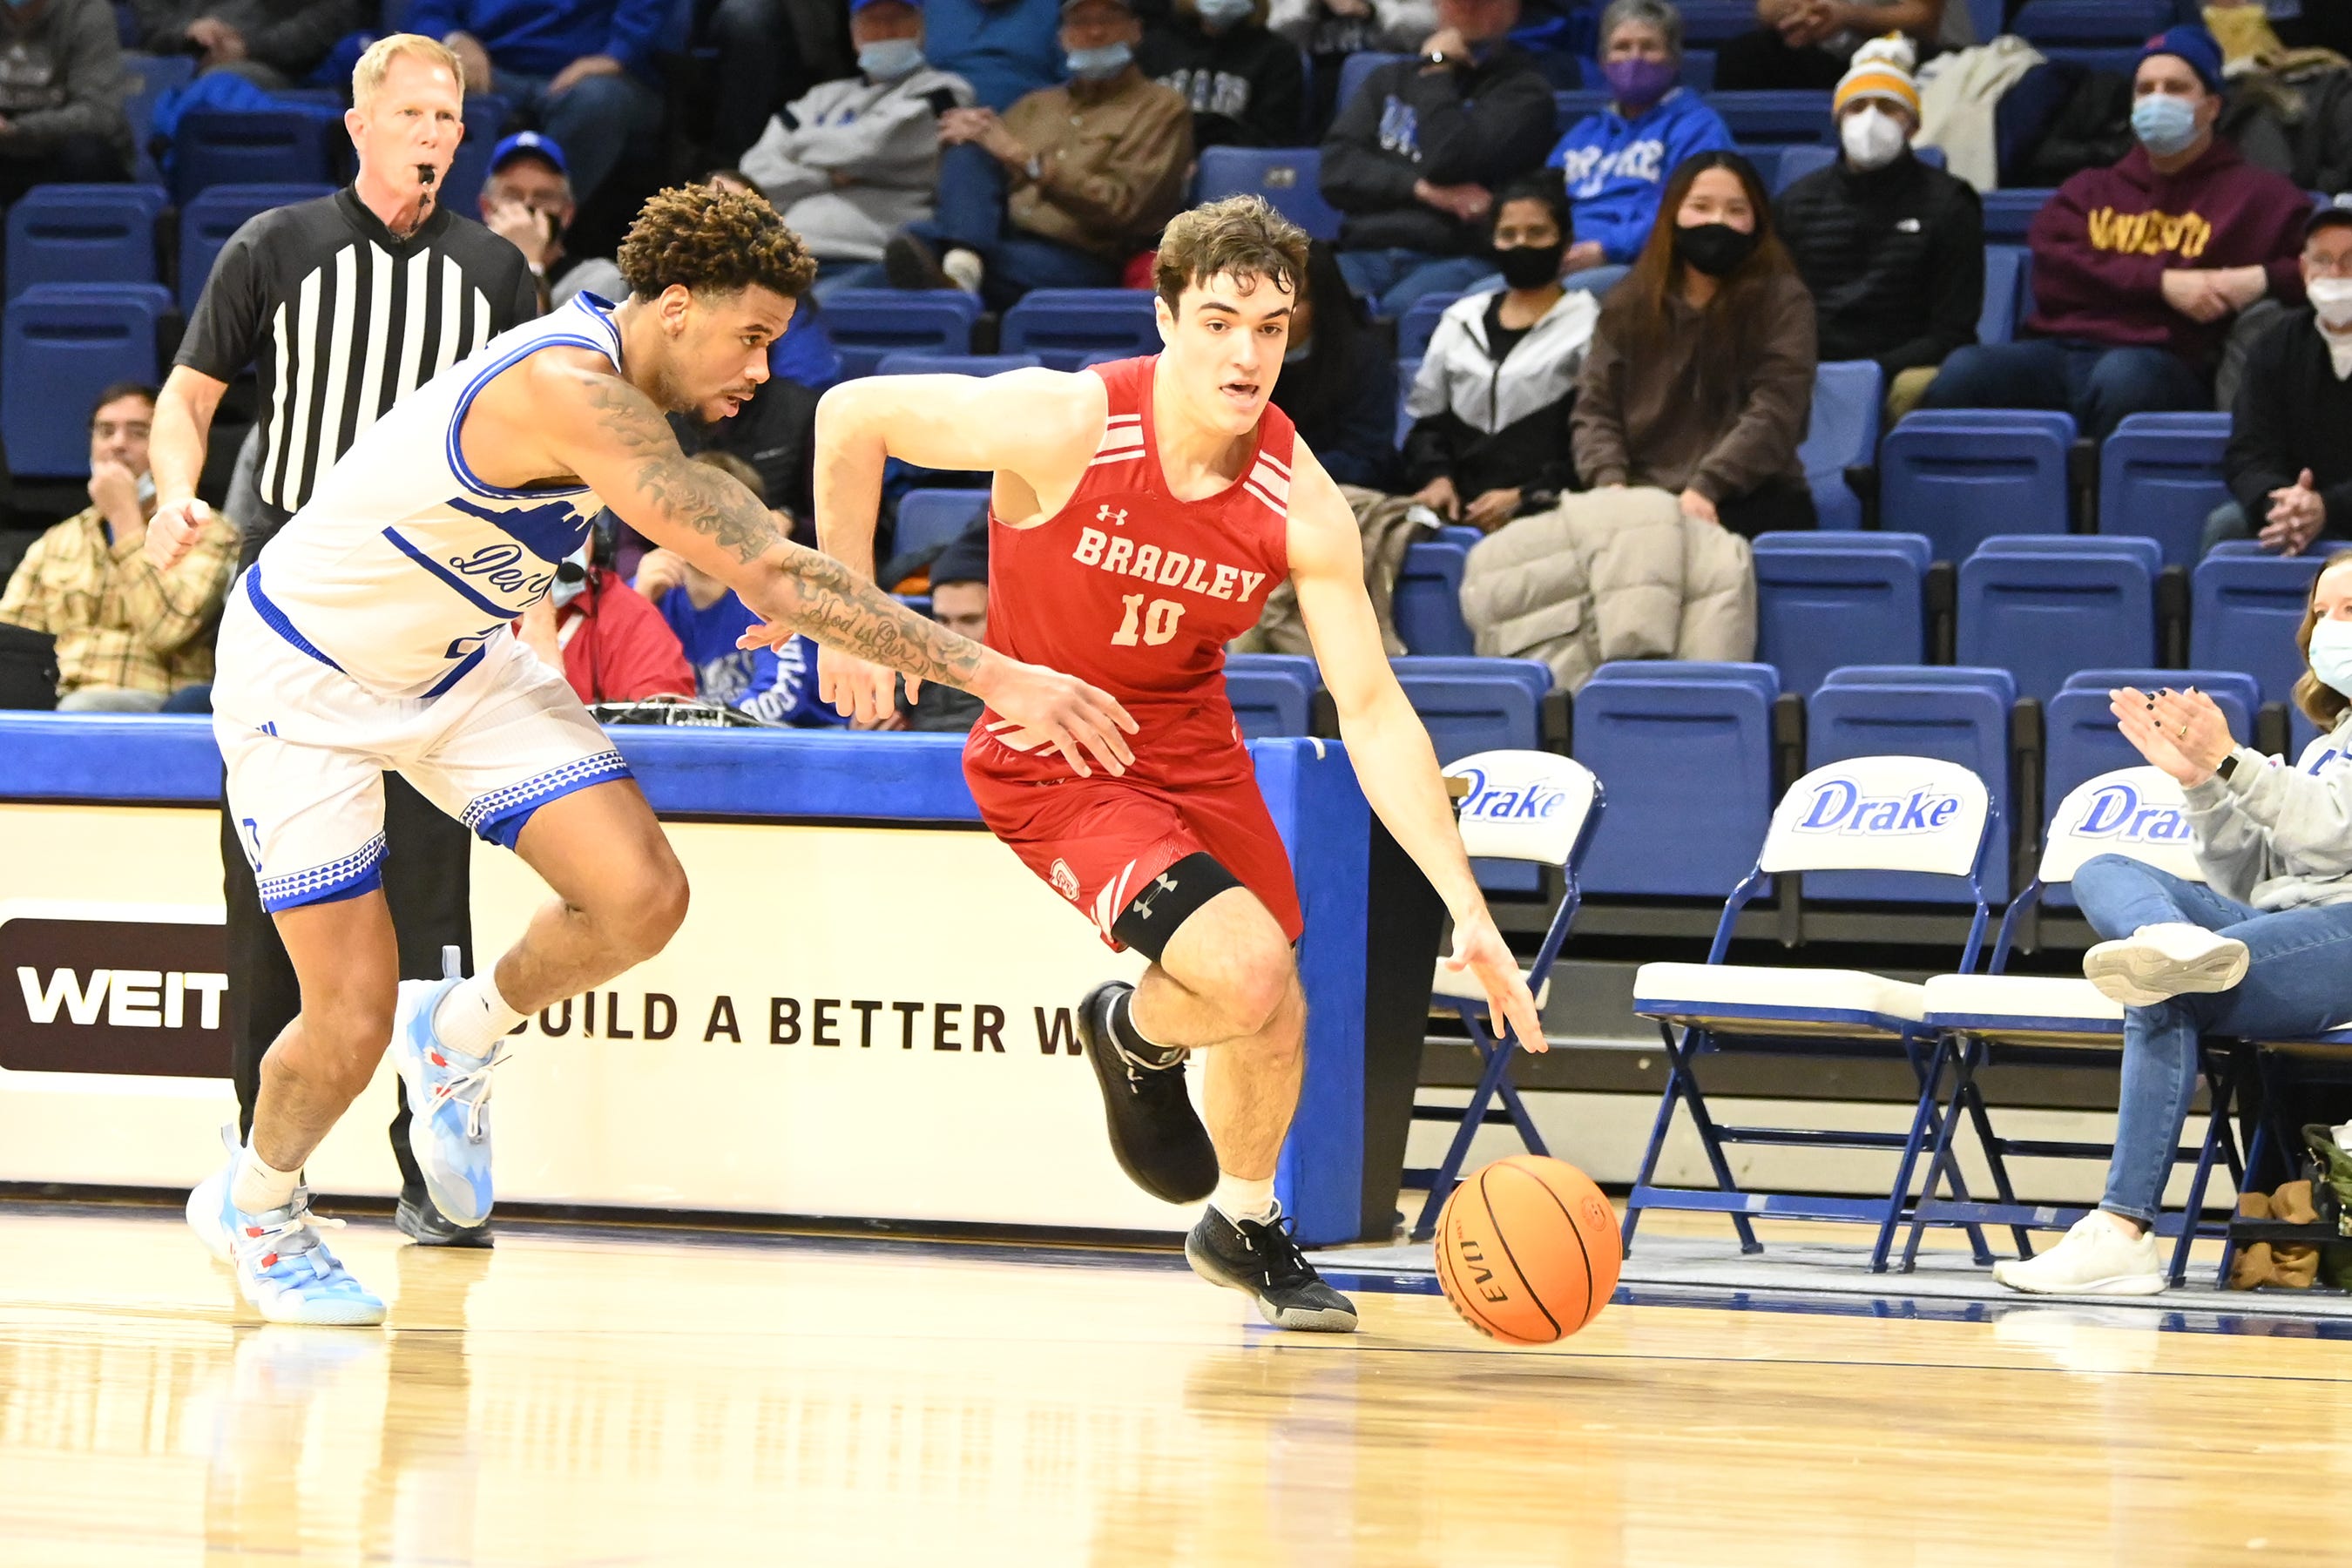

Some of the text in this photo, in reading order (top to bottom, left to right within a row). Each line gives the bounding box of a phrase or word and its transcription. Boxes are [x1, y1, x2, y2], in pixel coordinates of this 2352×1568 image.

[449, 544, 542, 593] Des
[1072, 526, 1267, 603] BRADLEY
[1111, 593, 1186, 646] 10
[1801, 780, 1958, 831] Drake
[505, 991, 678, 1040] UILD
[703, 995, 741, 1043] A
[770, 997, 1005, 1053] BETTER
[1460, 1240, 1509, 1303] EVO
